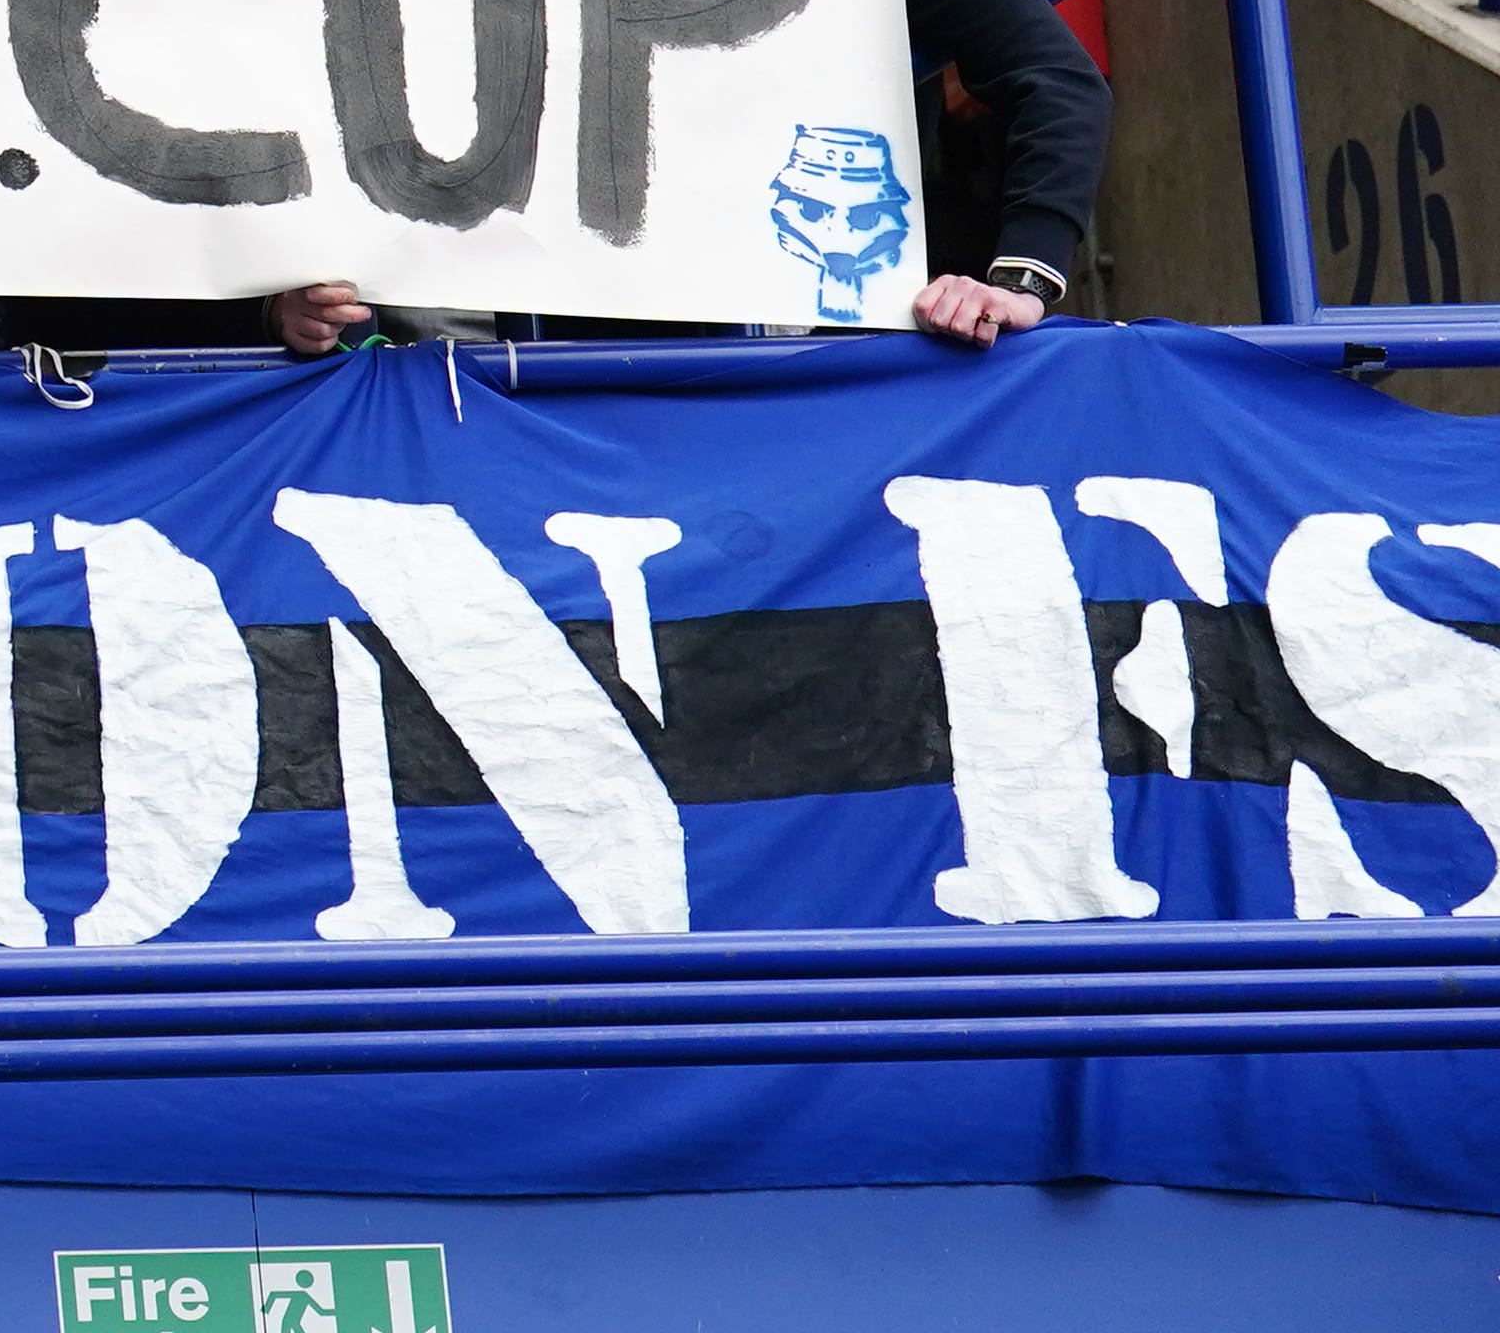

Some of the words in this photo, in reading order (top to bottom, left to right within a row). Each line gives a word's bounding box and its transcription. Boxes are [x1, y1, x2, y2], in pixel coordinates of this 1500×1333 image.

[1326, 103, 1462, 306] 26
[884, 475, 1500, 925] FS
[73, 1265, 210, 1323] Fire
